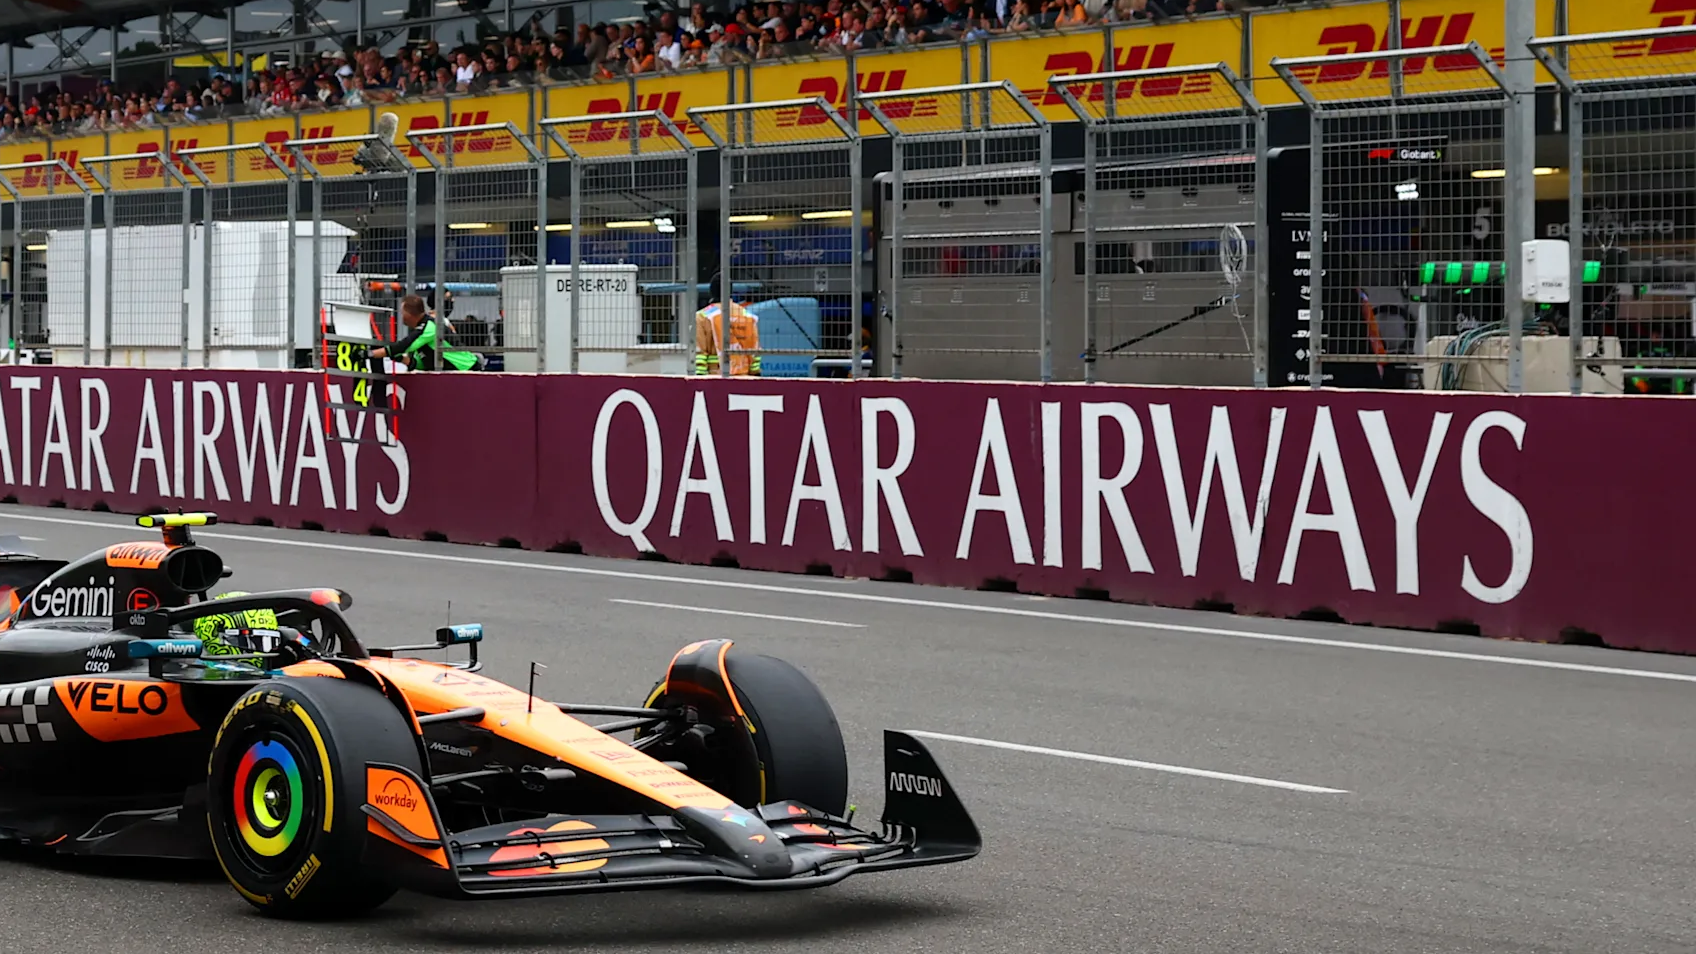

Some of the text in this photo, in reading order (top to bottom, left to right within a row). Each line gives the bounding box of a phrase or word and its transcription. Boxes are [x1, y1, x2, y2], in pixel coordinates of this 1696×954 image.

[1316, 12, 1484, 82] DHL
[1041, 42, 1185, 106] DHL
[586, 91, 687, 143] DHL
[796, 69, 915, 127] DHL
[263, 125, 340, 170] DHL
[407, 110, 495, 158] DHL
[22, 149, 82, 189] DHL
[135, 138, 201, 180] DHL
[352, 378, 369, 408] 4
[129, 377, 411, 516] AIRWAYS
[590, 388, 1534, 605] QATAR AIRWAYS
[109, 545, 164, 566] allwyn
[31, 576, 115, 618] Gemini
[129, 614, 146, 625] okta
[456, 627, 480, 640] allwyn
[157, 642, 196, 655] allwyn
[67, 681, 168, 716] VELO
[430, 741, 473, 758] McLaren
[375, 793, 418, 812] workday
[889, 771, 943, 798] ARROW
